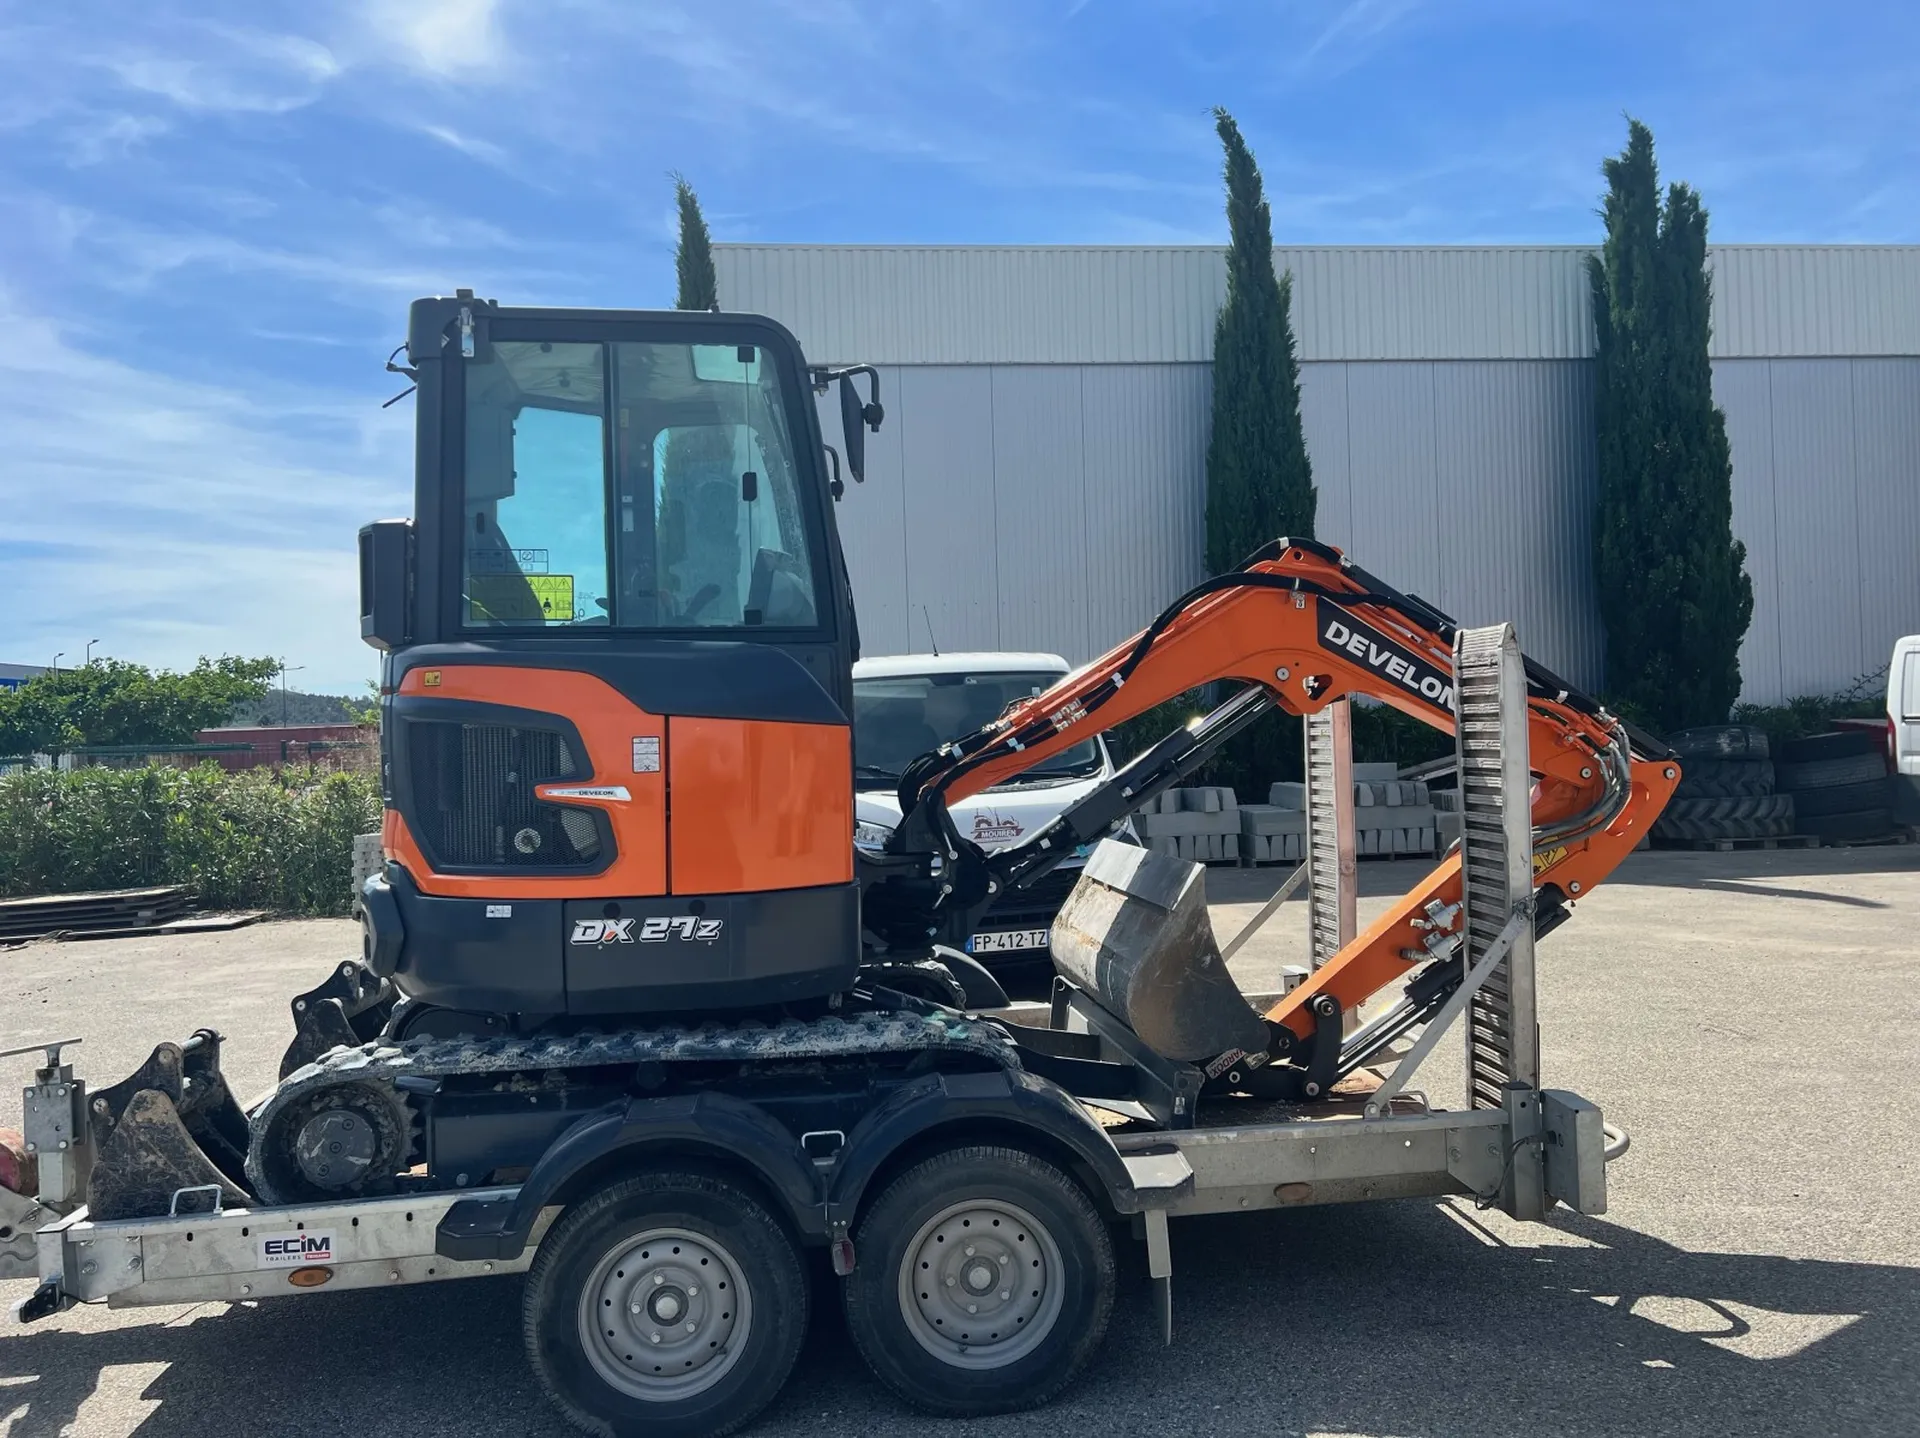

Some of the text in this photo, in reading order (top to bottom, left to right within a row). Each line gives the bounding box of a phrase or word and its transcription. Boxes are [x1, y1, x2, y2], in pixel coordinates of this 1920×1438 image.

[1324, 620, 1457, 712] DEVELON
[571, 918, 636, 945] DX
[973, 931, 1047, 951] FP-412-TZ
